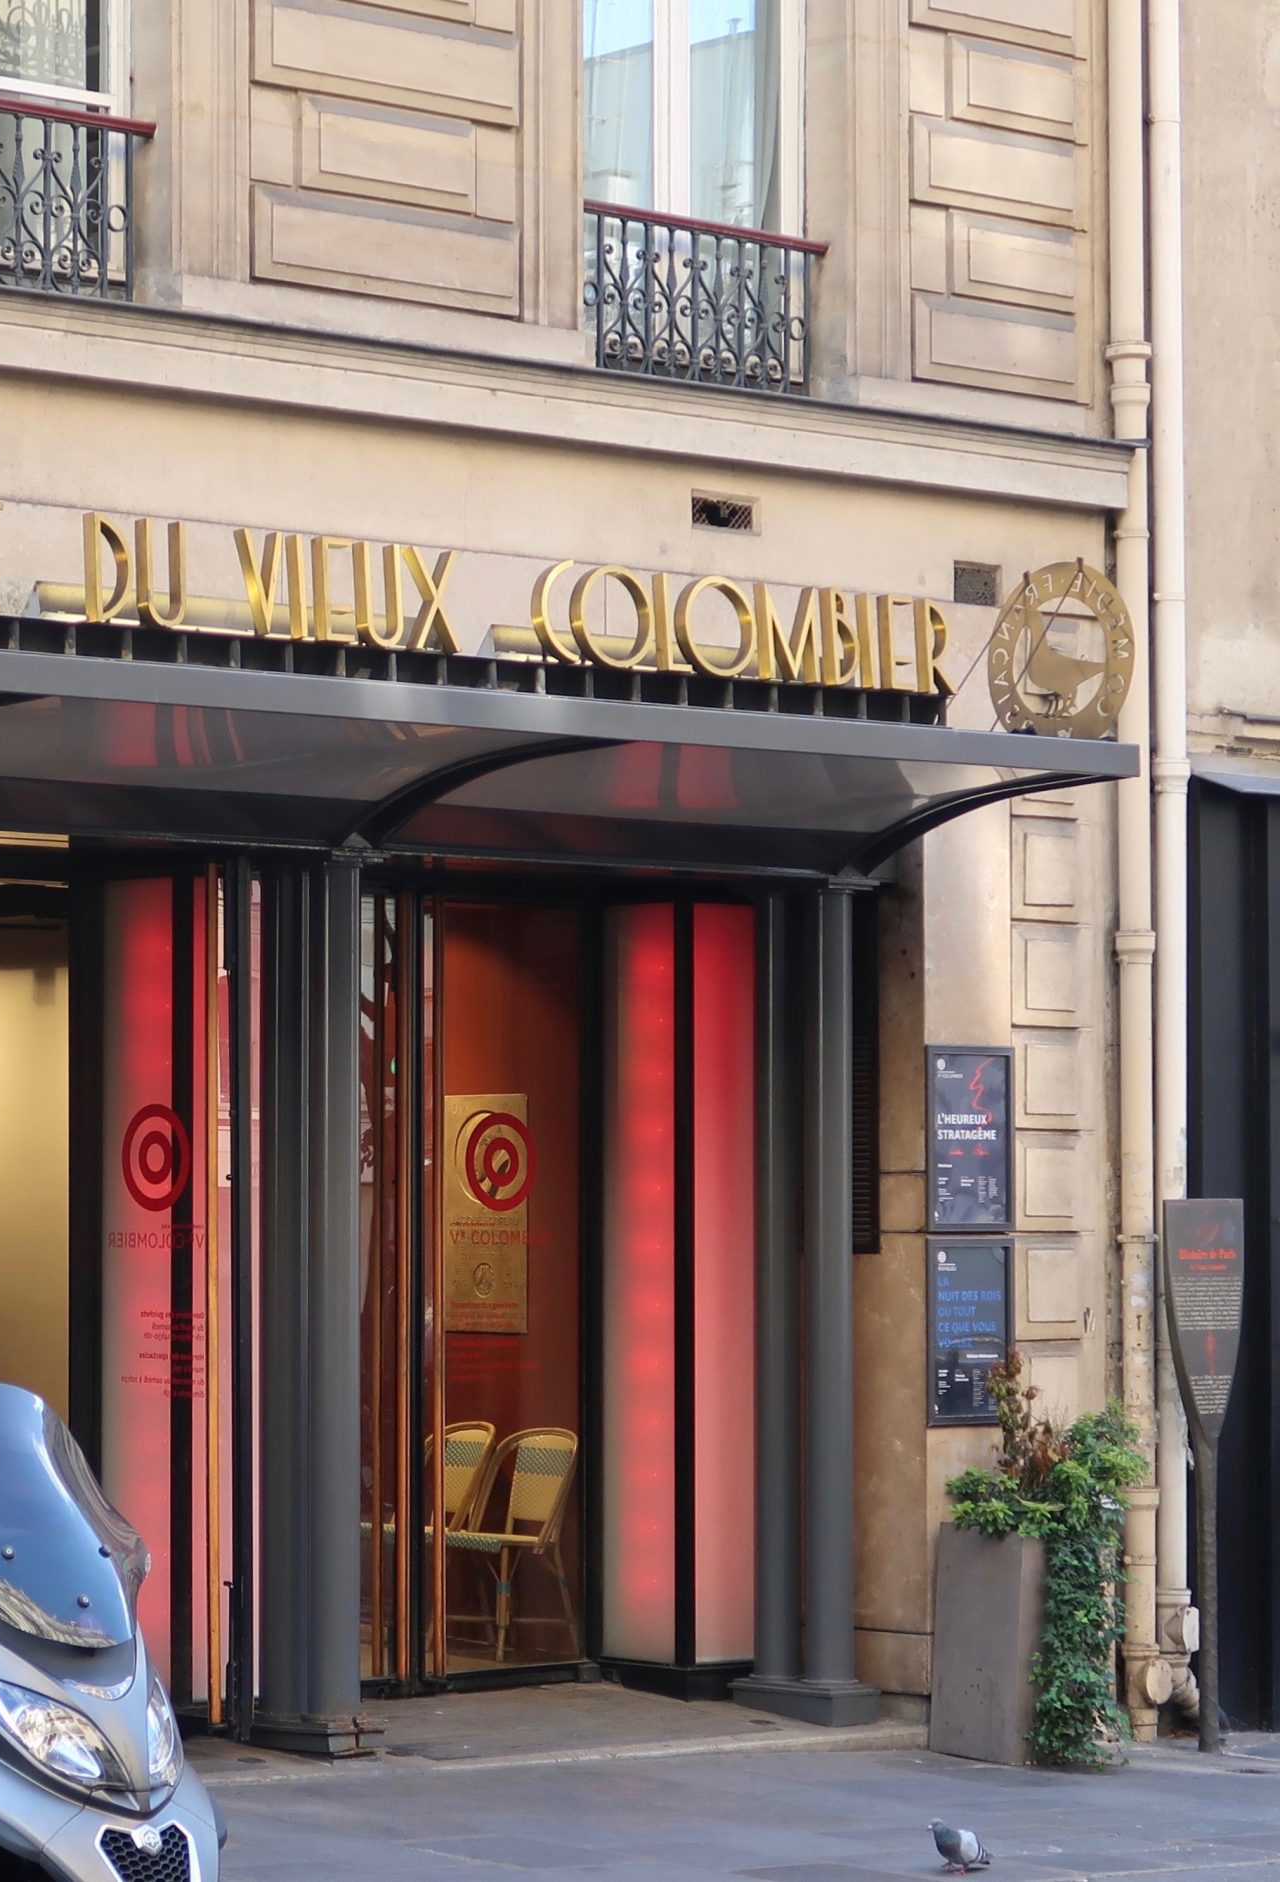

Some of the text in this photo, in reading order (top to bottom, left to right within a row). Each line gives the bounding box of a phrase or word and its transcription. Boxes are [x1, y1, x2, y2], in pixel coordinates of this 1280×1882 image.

[83, 512, 186, 628] DU
[233, 527, 462, 653] VIEUX
[532, 559, 958, 695] COLOMBIER
[937, 1112, 987, 1125] L'HEUREUX
